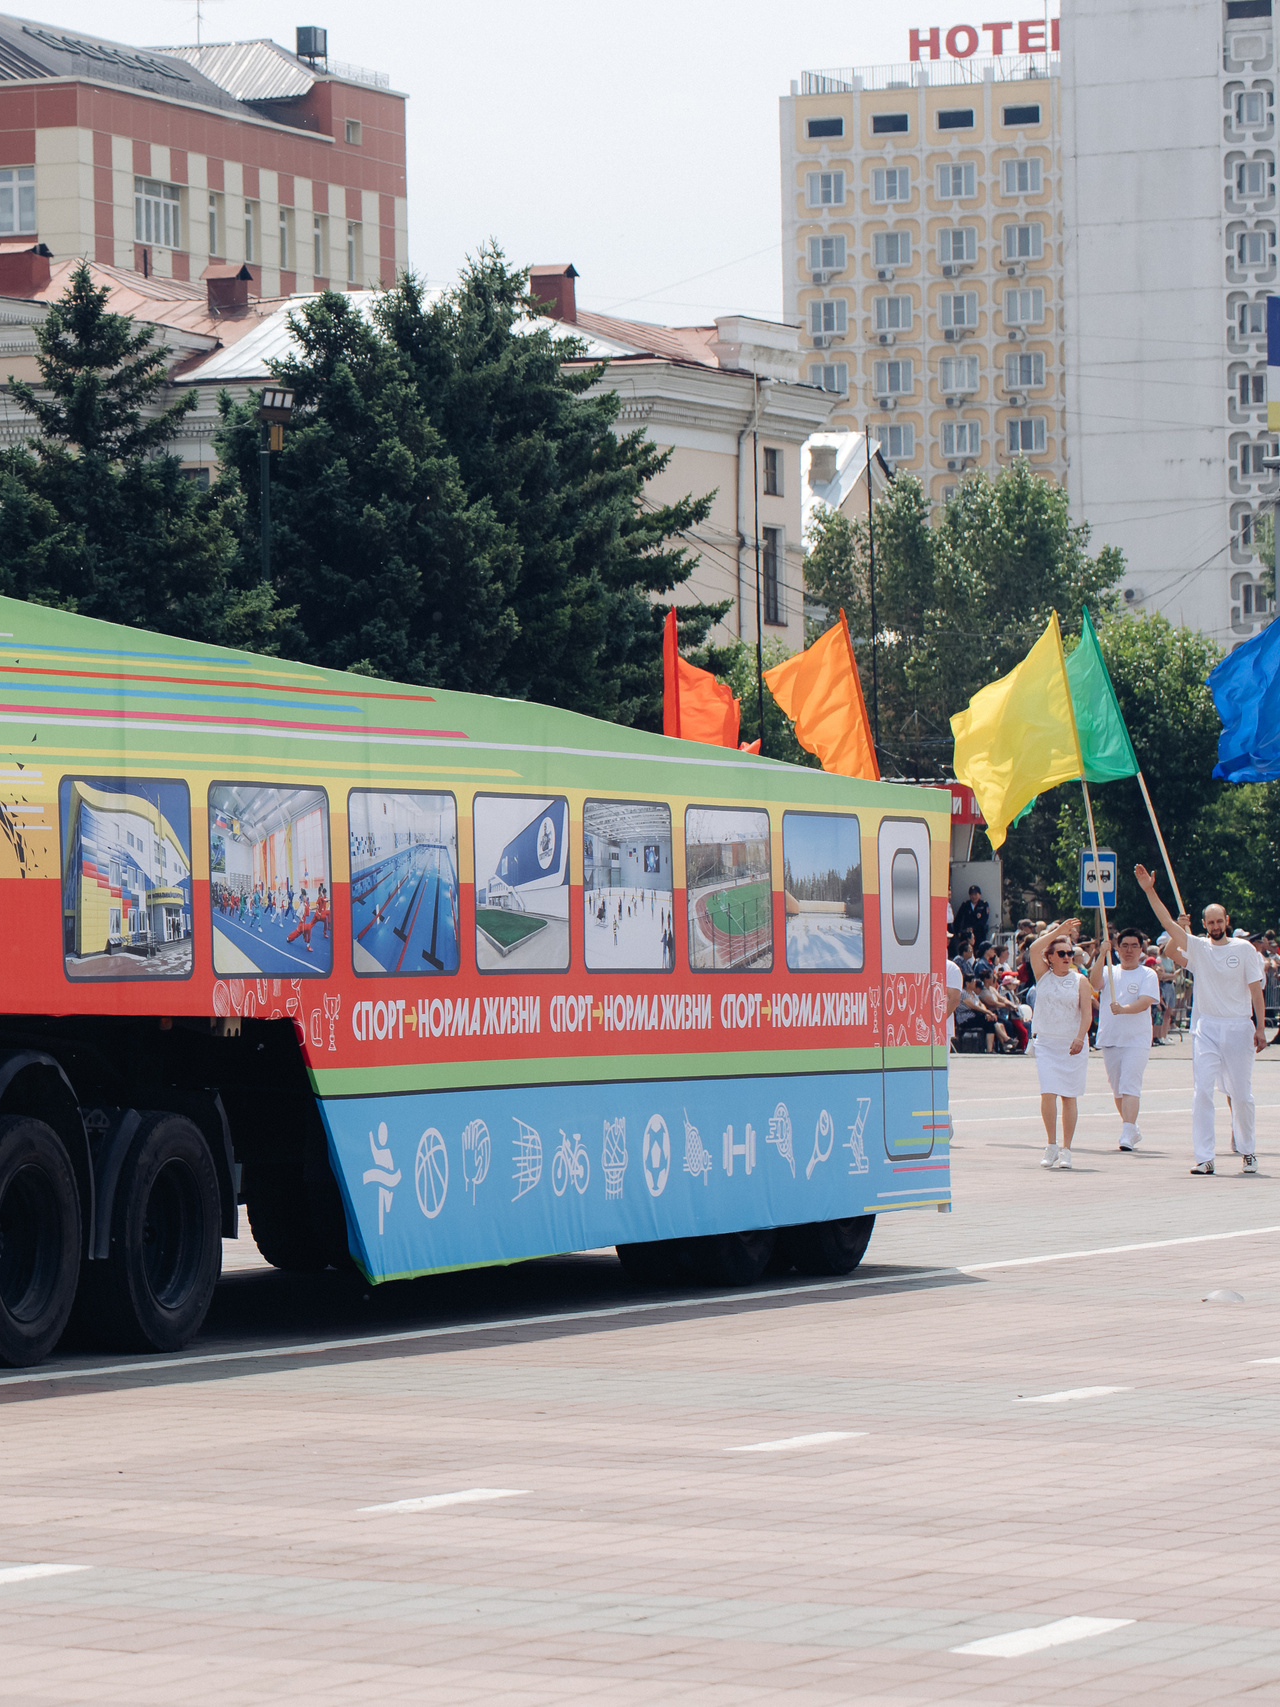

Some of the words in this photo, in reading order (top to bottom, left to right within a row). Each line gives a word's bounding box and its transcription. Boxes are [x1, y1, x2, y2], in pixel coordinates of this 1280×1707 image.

[352, 1000, 406, 1041] СПОРТ
[418, 997, 481, 1038] НОРМА
[482, 996, 541, 1035] ЖИЗНИ
[549, 995, 594, 1032] СПОРТ
[604, 994, 659, 1031] НОРМА
[660, 994, 712, 1030] ЖИЗНИ
[721, 993, 763, 1028] СПОРТ
[771, 993, 822, 1028] НОРМА
[821, 992, 868, 1026] ЖИЗНИ
